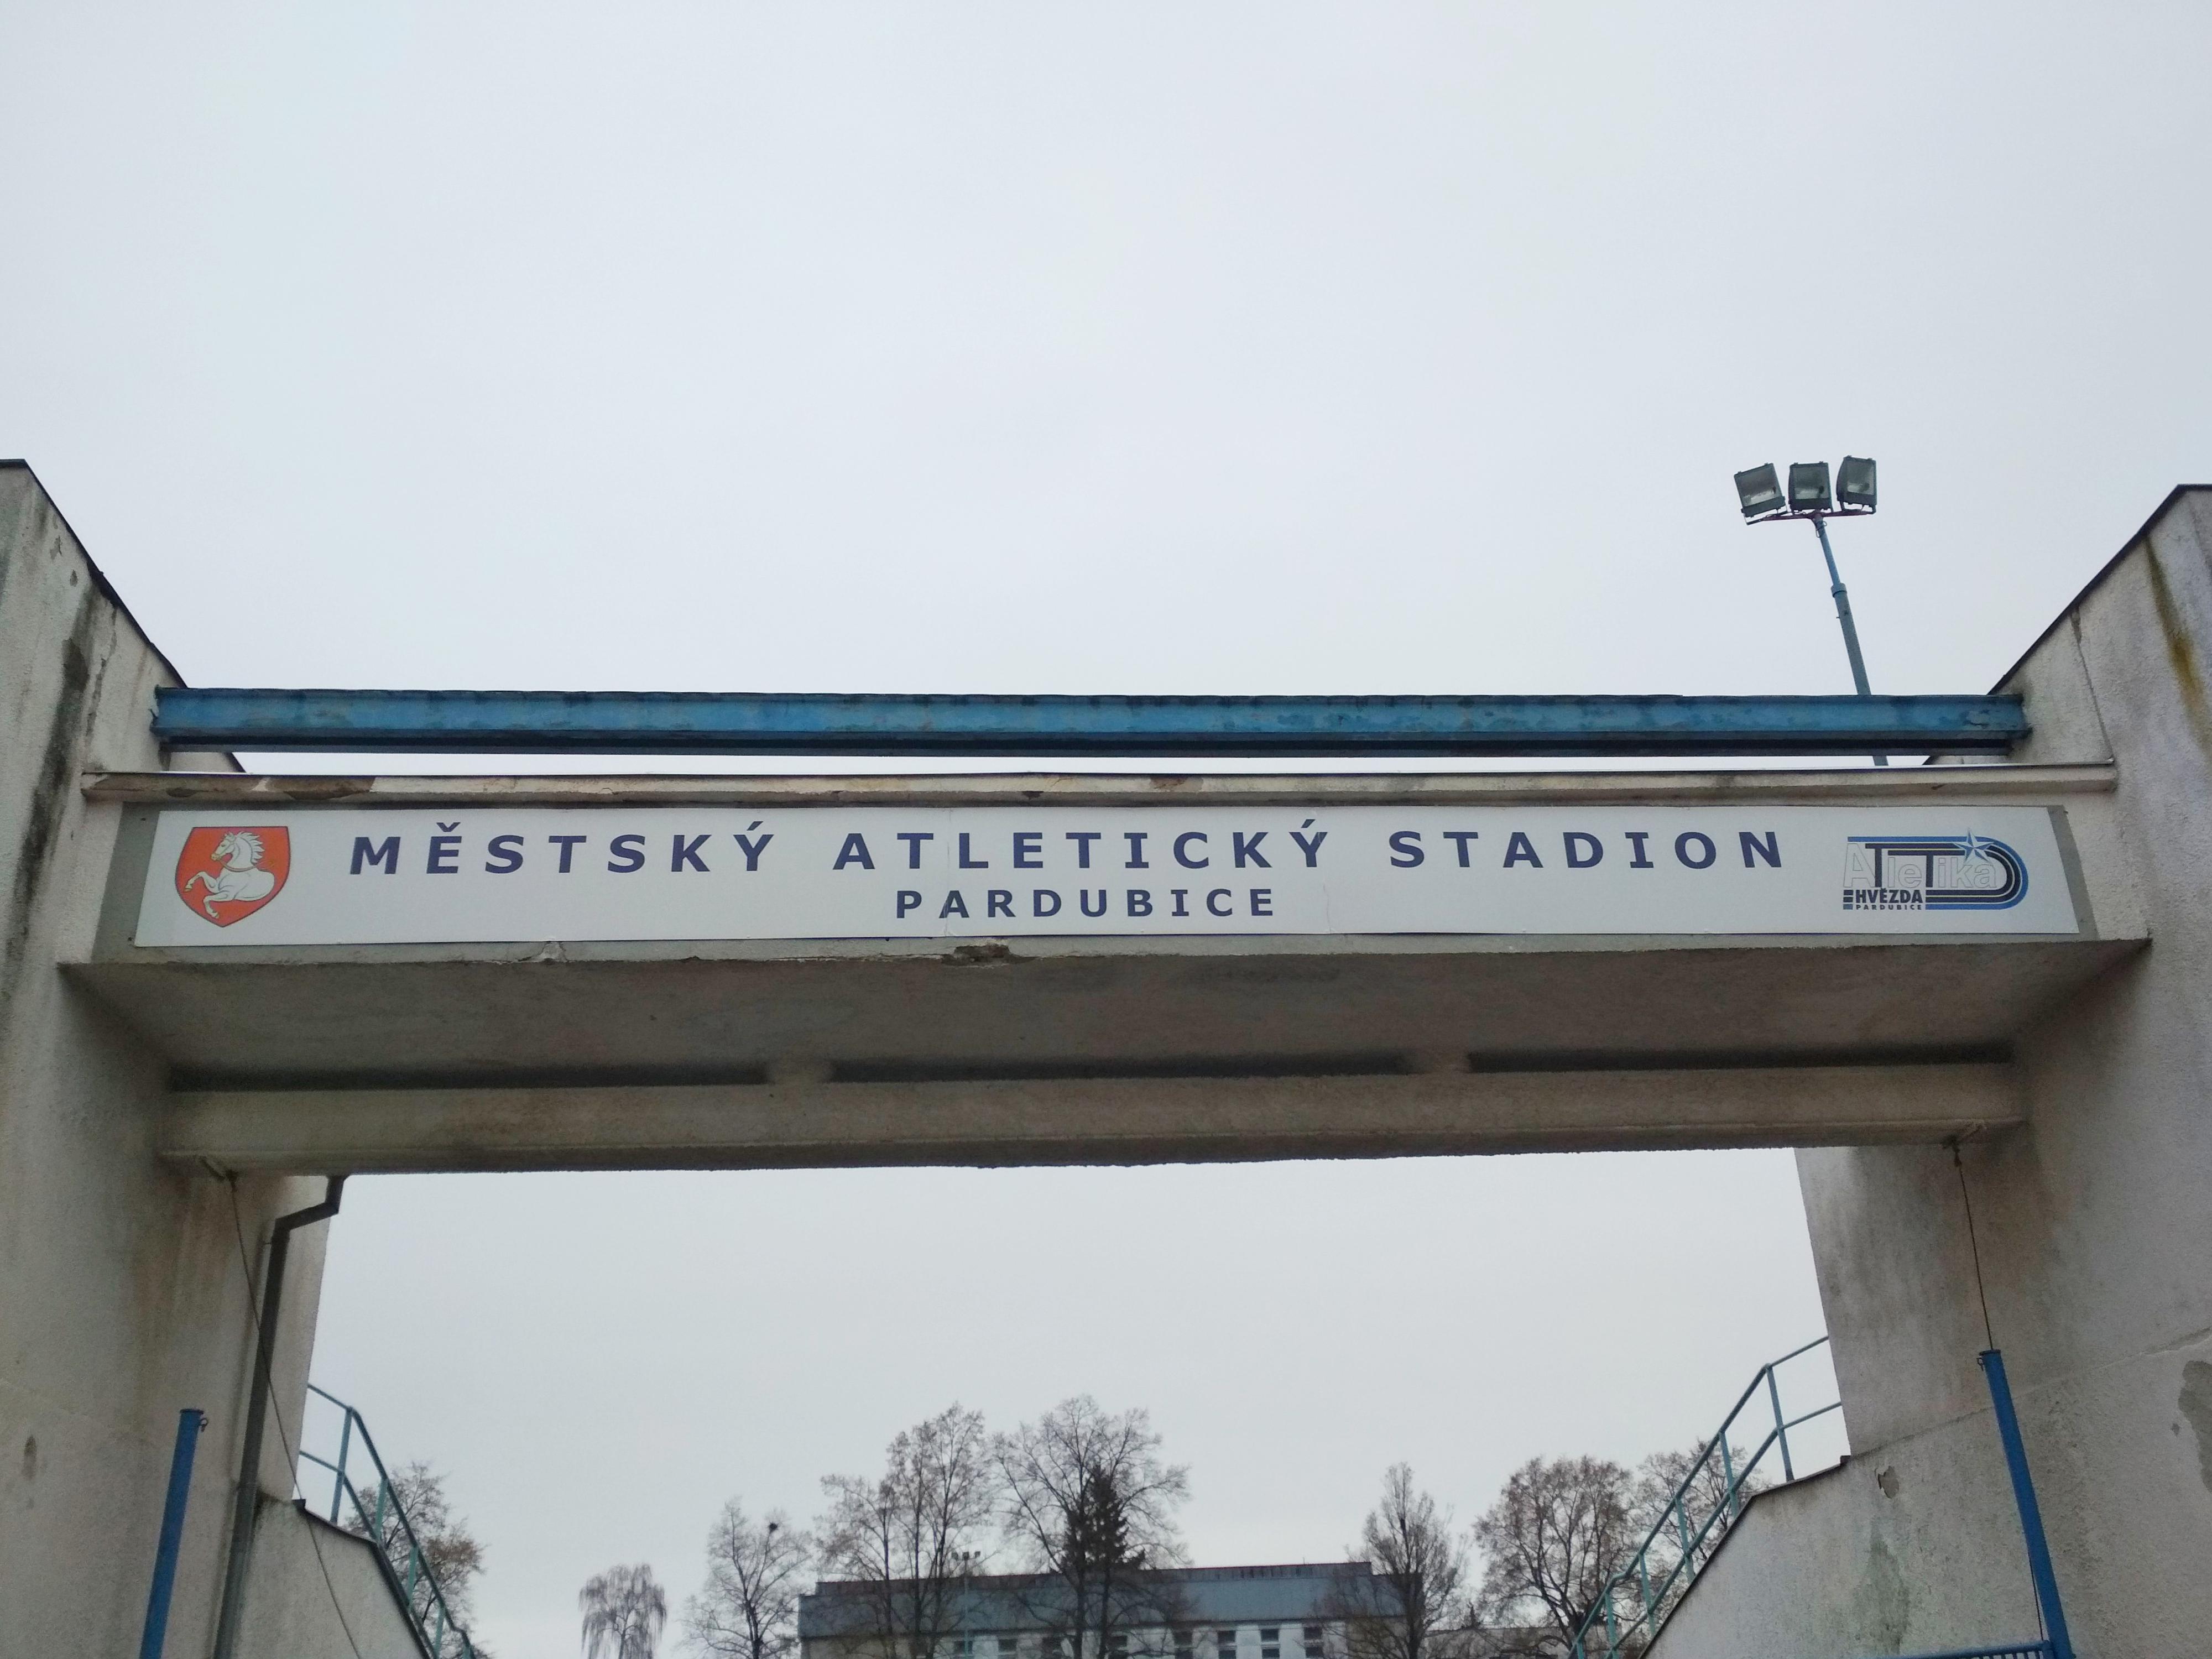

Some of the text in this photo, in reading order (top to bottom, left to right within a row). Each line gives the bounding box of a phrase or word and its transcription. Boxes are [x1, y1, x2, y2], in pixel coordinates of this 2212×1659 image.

[349, 818, 1782, 875] MĚSTSKÝ ATLETICKÝ STADION
[896, 888, 1274, 919] PARDUBICE
[1855, 887, 1923, 904] HVĚZDA
